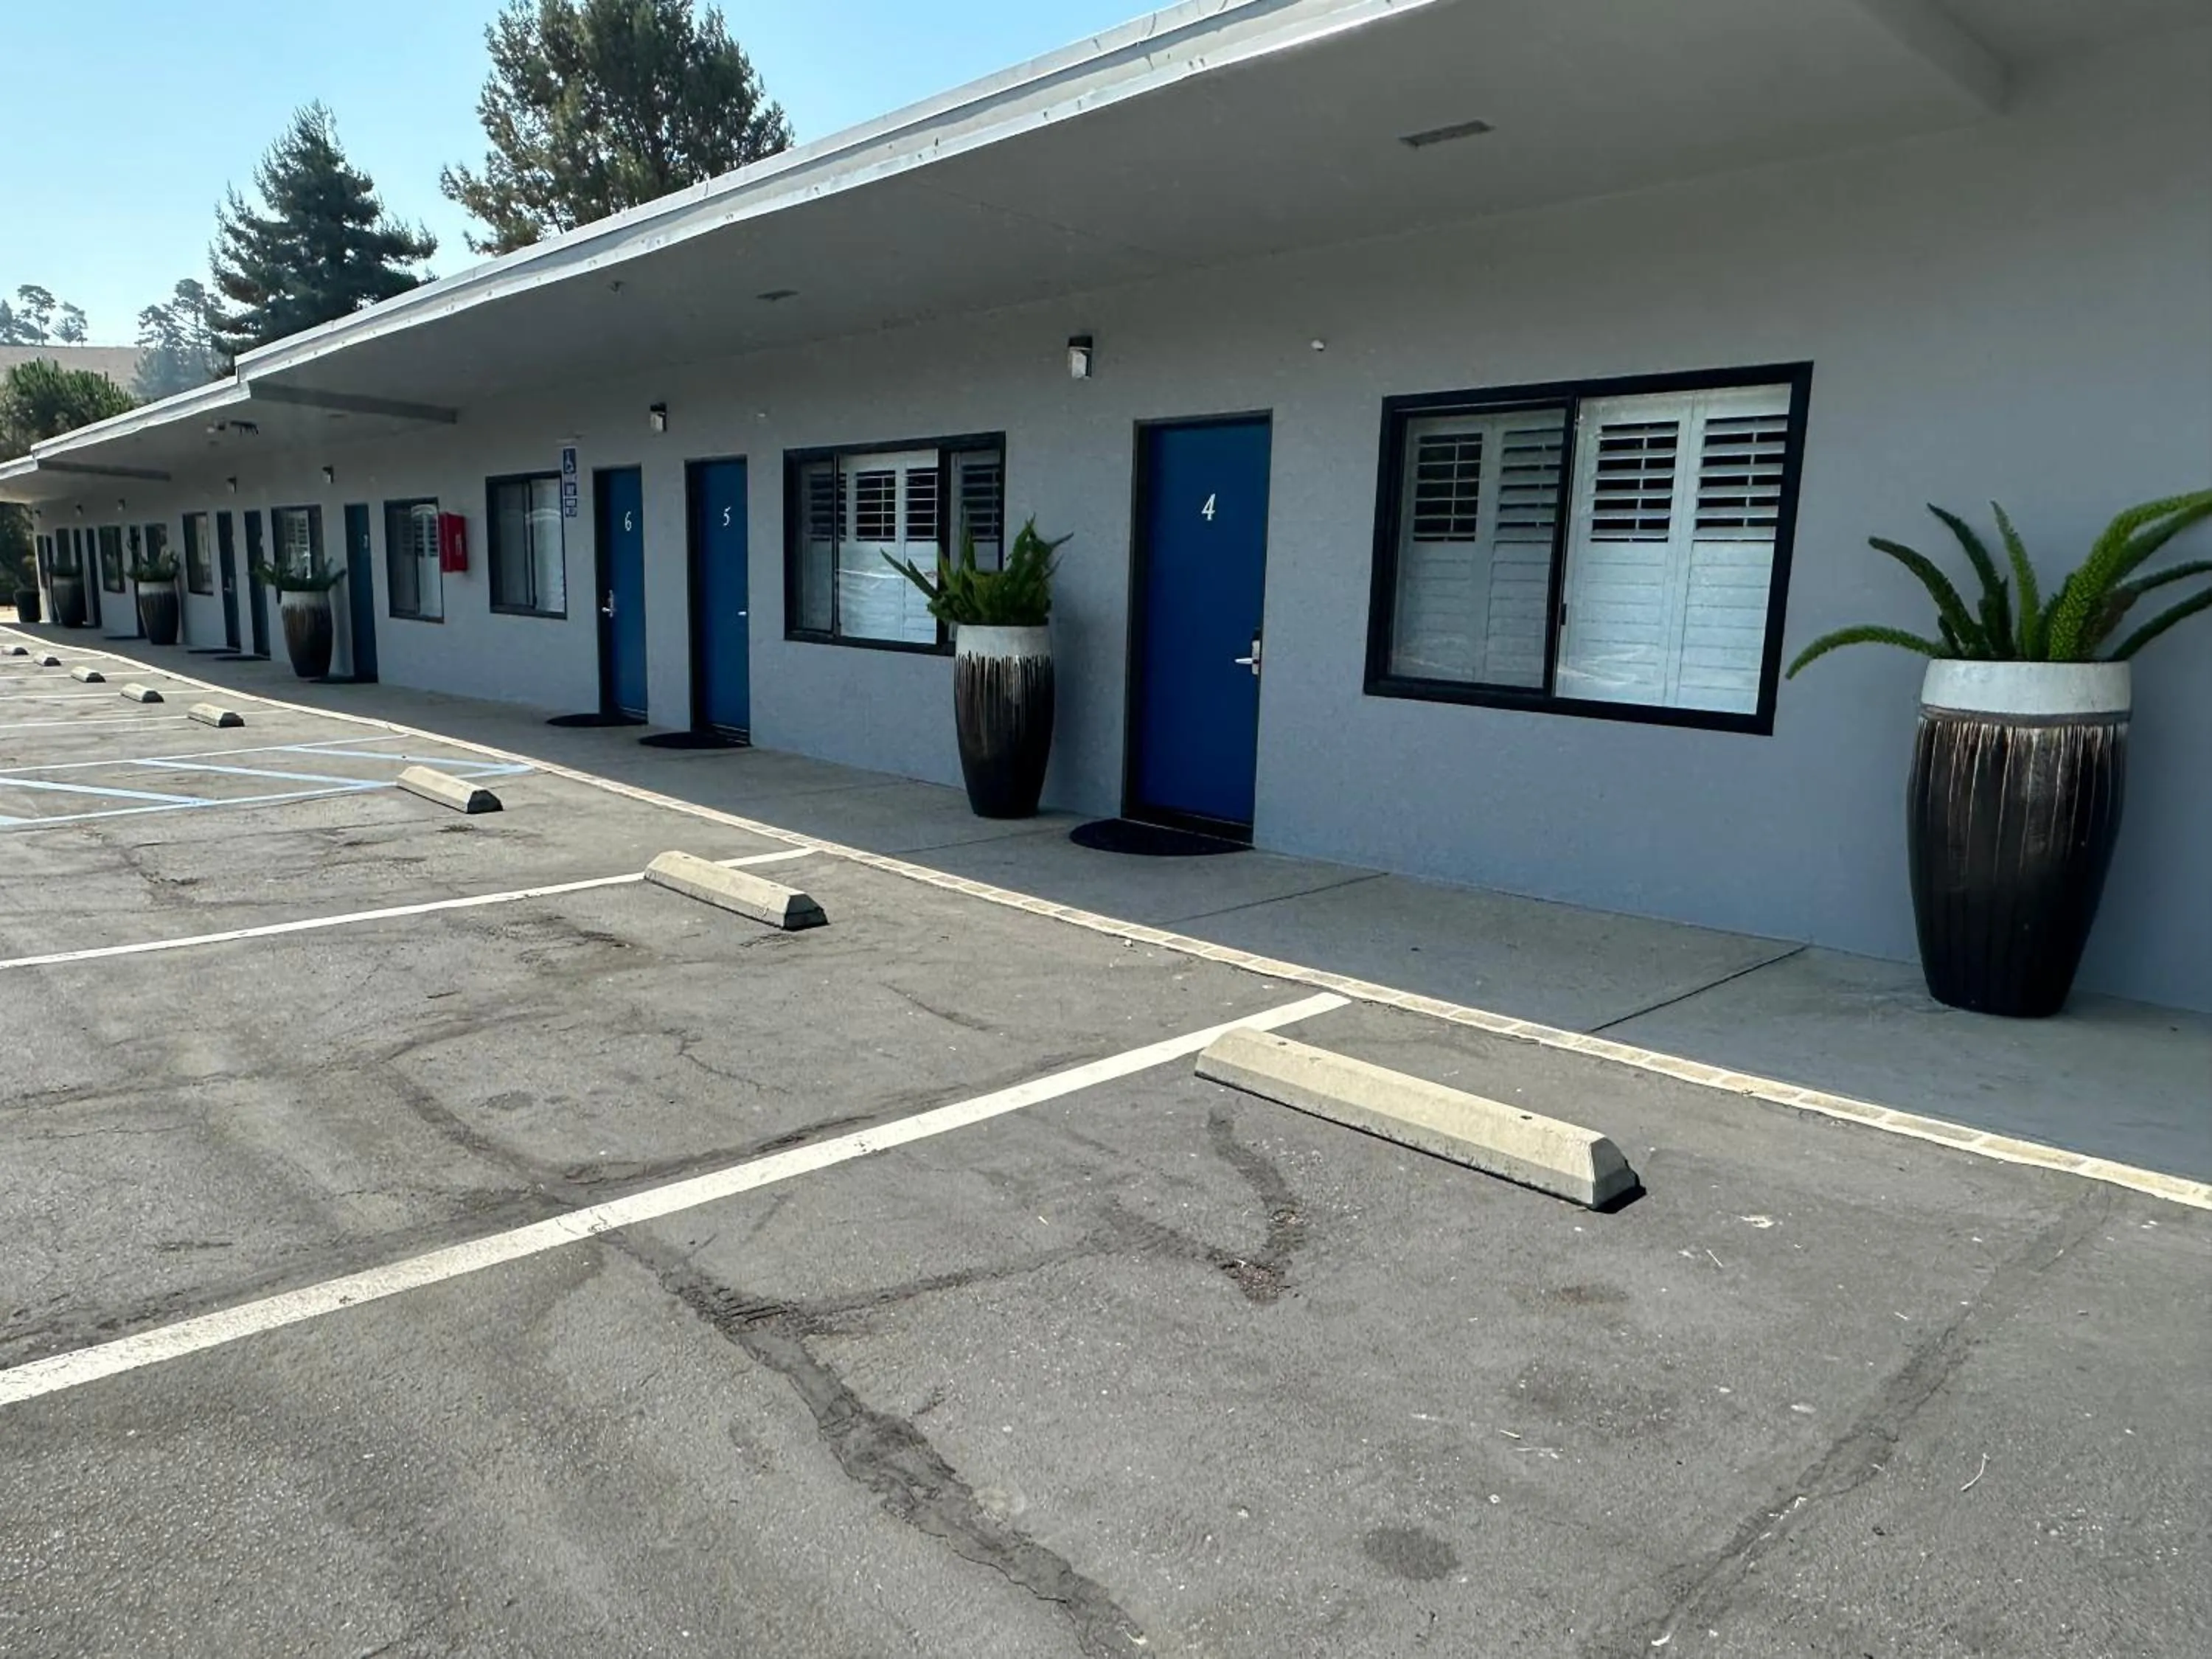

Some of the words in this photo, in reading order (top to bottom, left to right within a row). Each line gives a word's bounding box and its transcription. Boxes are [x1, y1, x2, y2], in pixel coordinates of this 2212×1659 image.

[723, 507, 731, 526] 5
[1201, 493, 1216, 521] 4
[625, 511, 632, 531] 6
